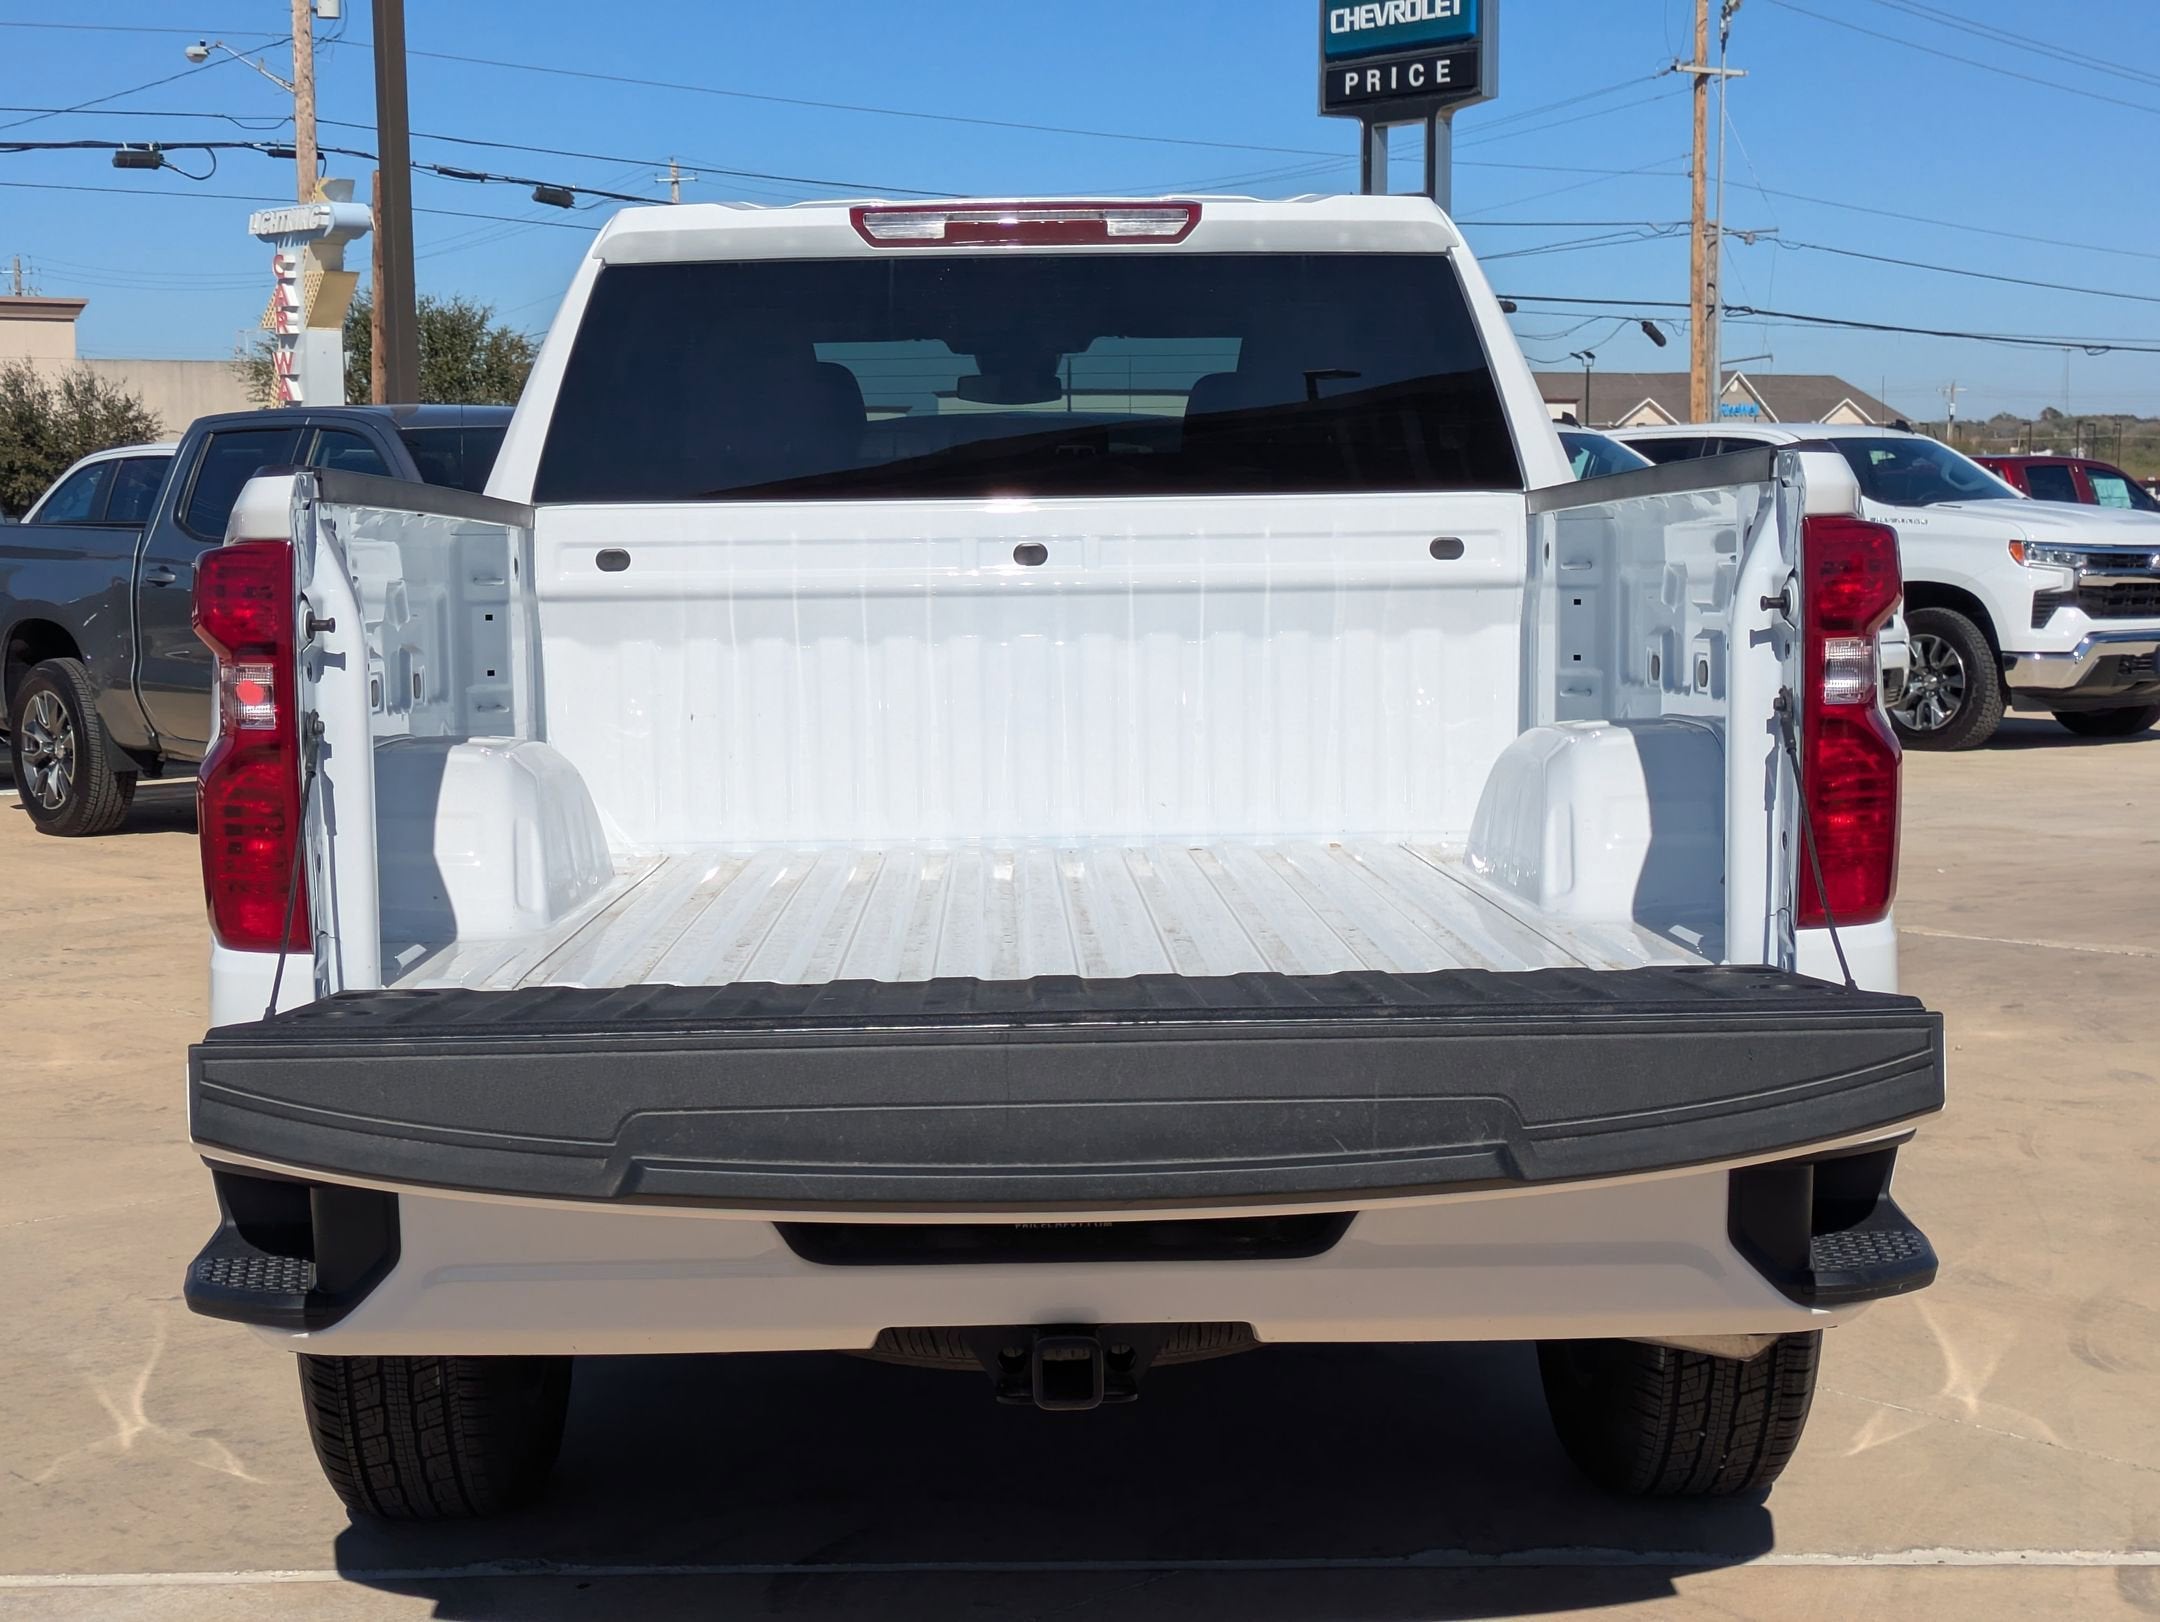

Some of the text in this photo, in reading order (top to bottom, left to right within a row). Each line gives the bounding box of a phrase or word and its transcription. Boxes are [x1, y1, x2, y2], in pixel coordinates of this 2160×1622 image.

[1330, 0, 1461, 34] CHEVROLET
[1344, 59, 1451, 96] PRICE
[248, 205, 322, 235] LIGHTNING
[271, 254, 291, 334] CAR
